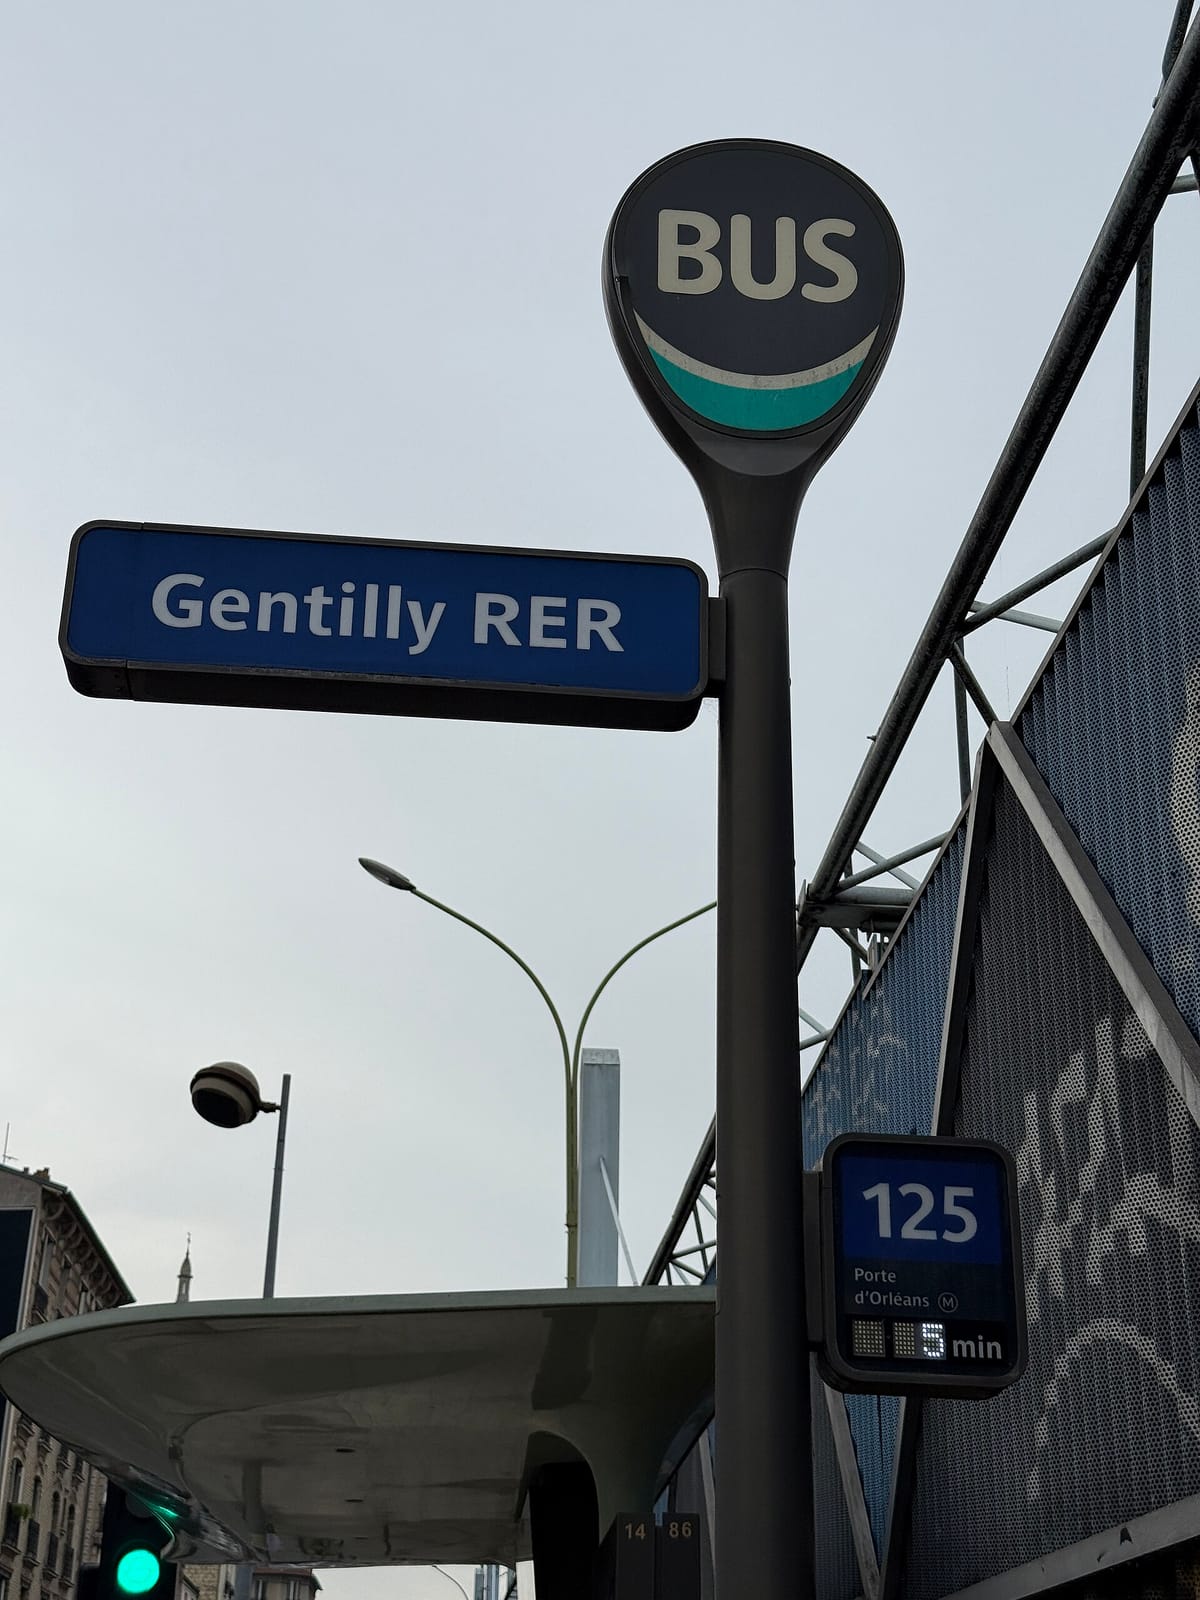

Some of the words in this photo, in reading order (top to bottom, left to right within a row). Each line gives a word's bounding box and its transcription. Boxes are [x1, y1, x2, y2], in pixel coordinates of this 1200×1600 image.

[657, 208, 858, 303] BUS
[151, 573, 446, 655] Gentilly
[472, 592, 625, 652] RER
[862, 1182, 978, 1243] 125
[854, 1267, 897, 1283] Porte
[922, 1322, 945, 1358] 5
[952, 1335, 1002, 1360] min
[624, 1522, 647, 1540] 14
[668, 1521, 693, 1538] 86
